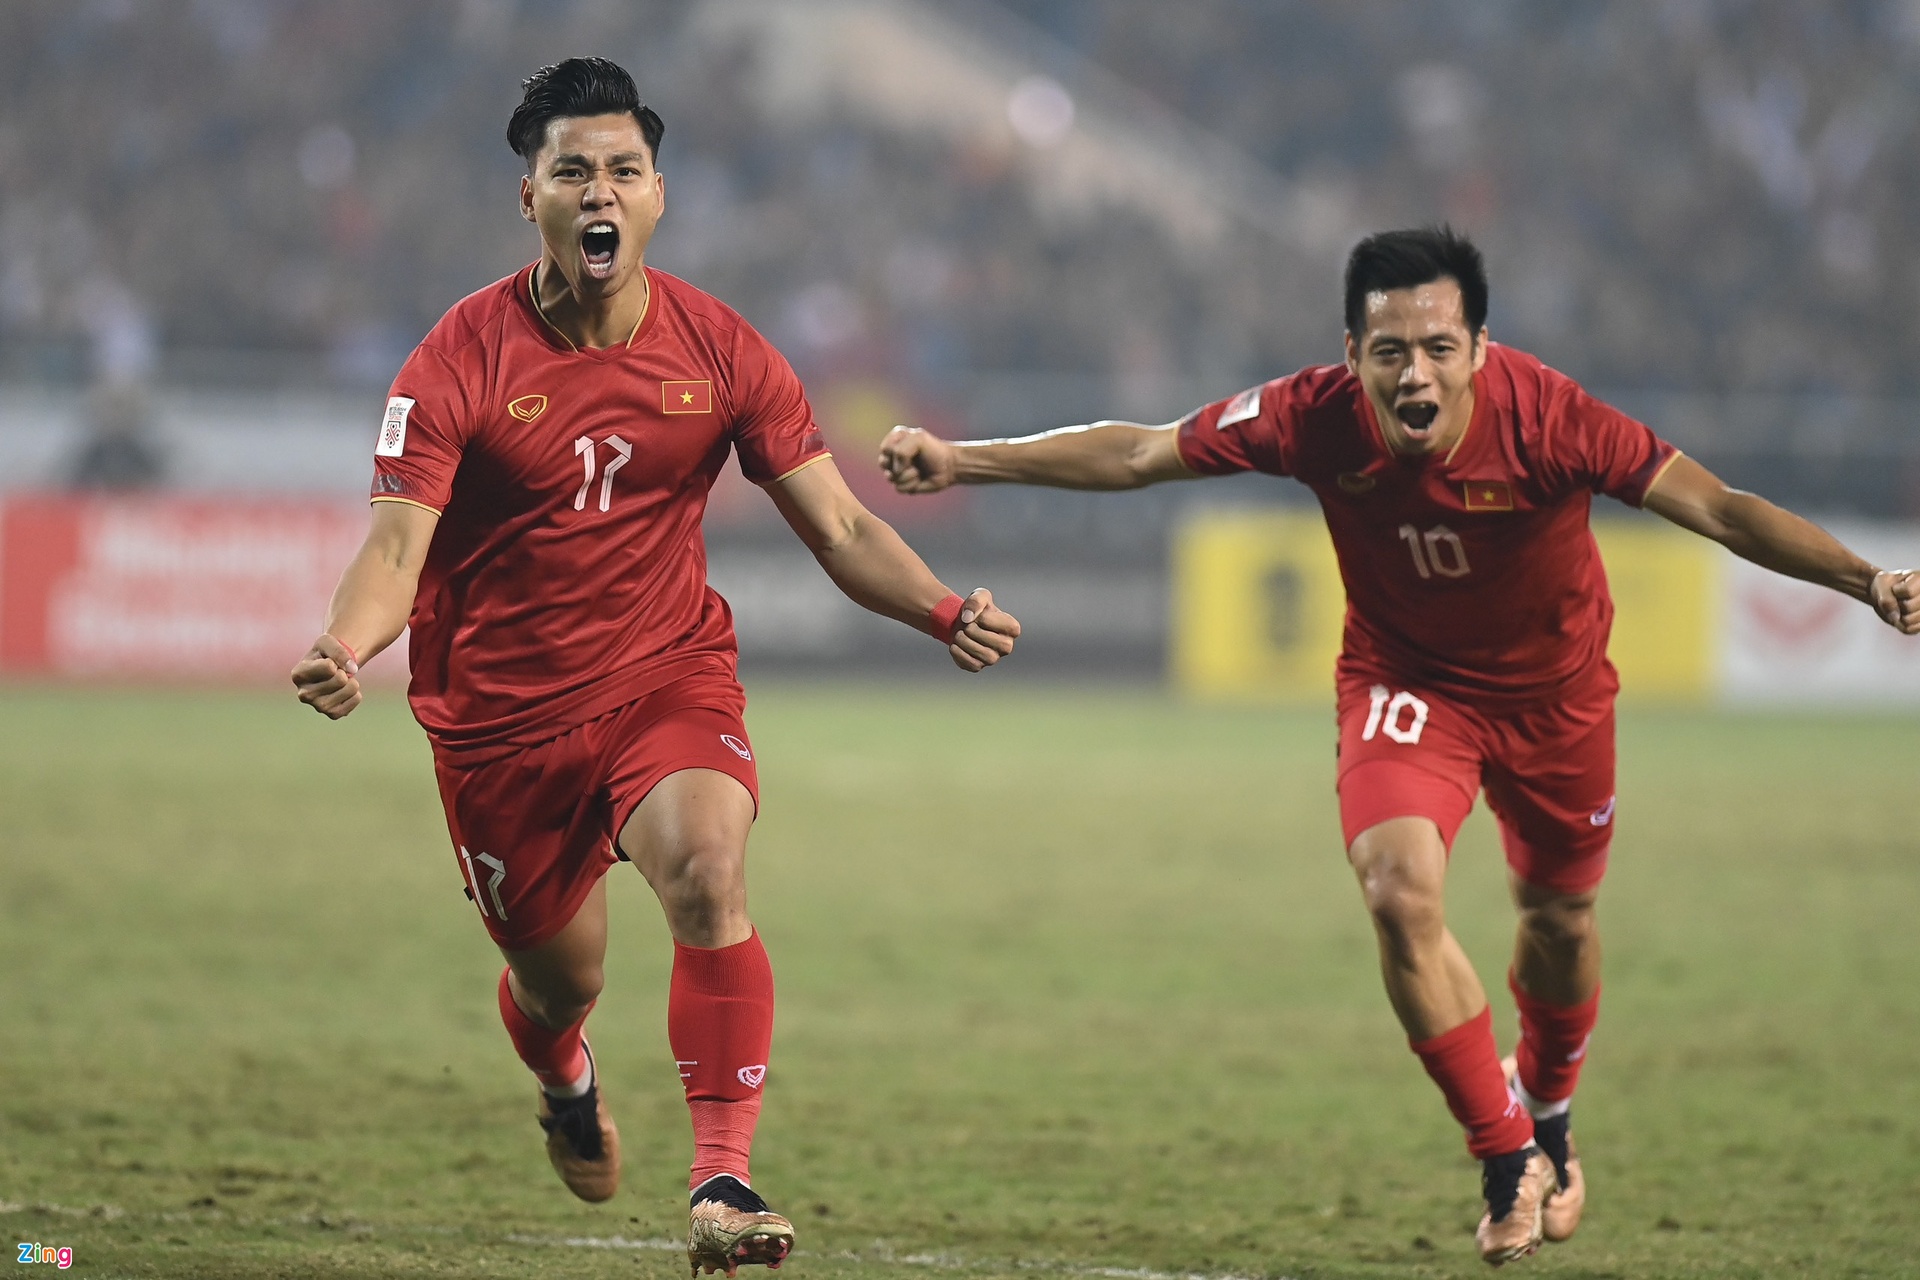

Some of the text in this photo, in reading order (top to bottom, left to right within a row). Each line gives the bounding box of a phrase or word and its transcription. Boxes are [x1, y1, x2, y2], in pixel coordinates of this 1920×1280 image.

[574, 434, 633, 513] 17
[1398, 523, 1471, 579] 10
[1361, 683, 1430, 745] 10
[459, 844, 509, 921] 17
